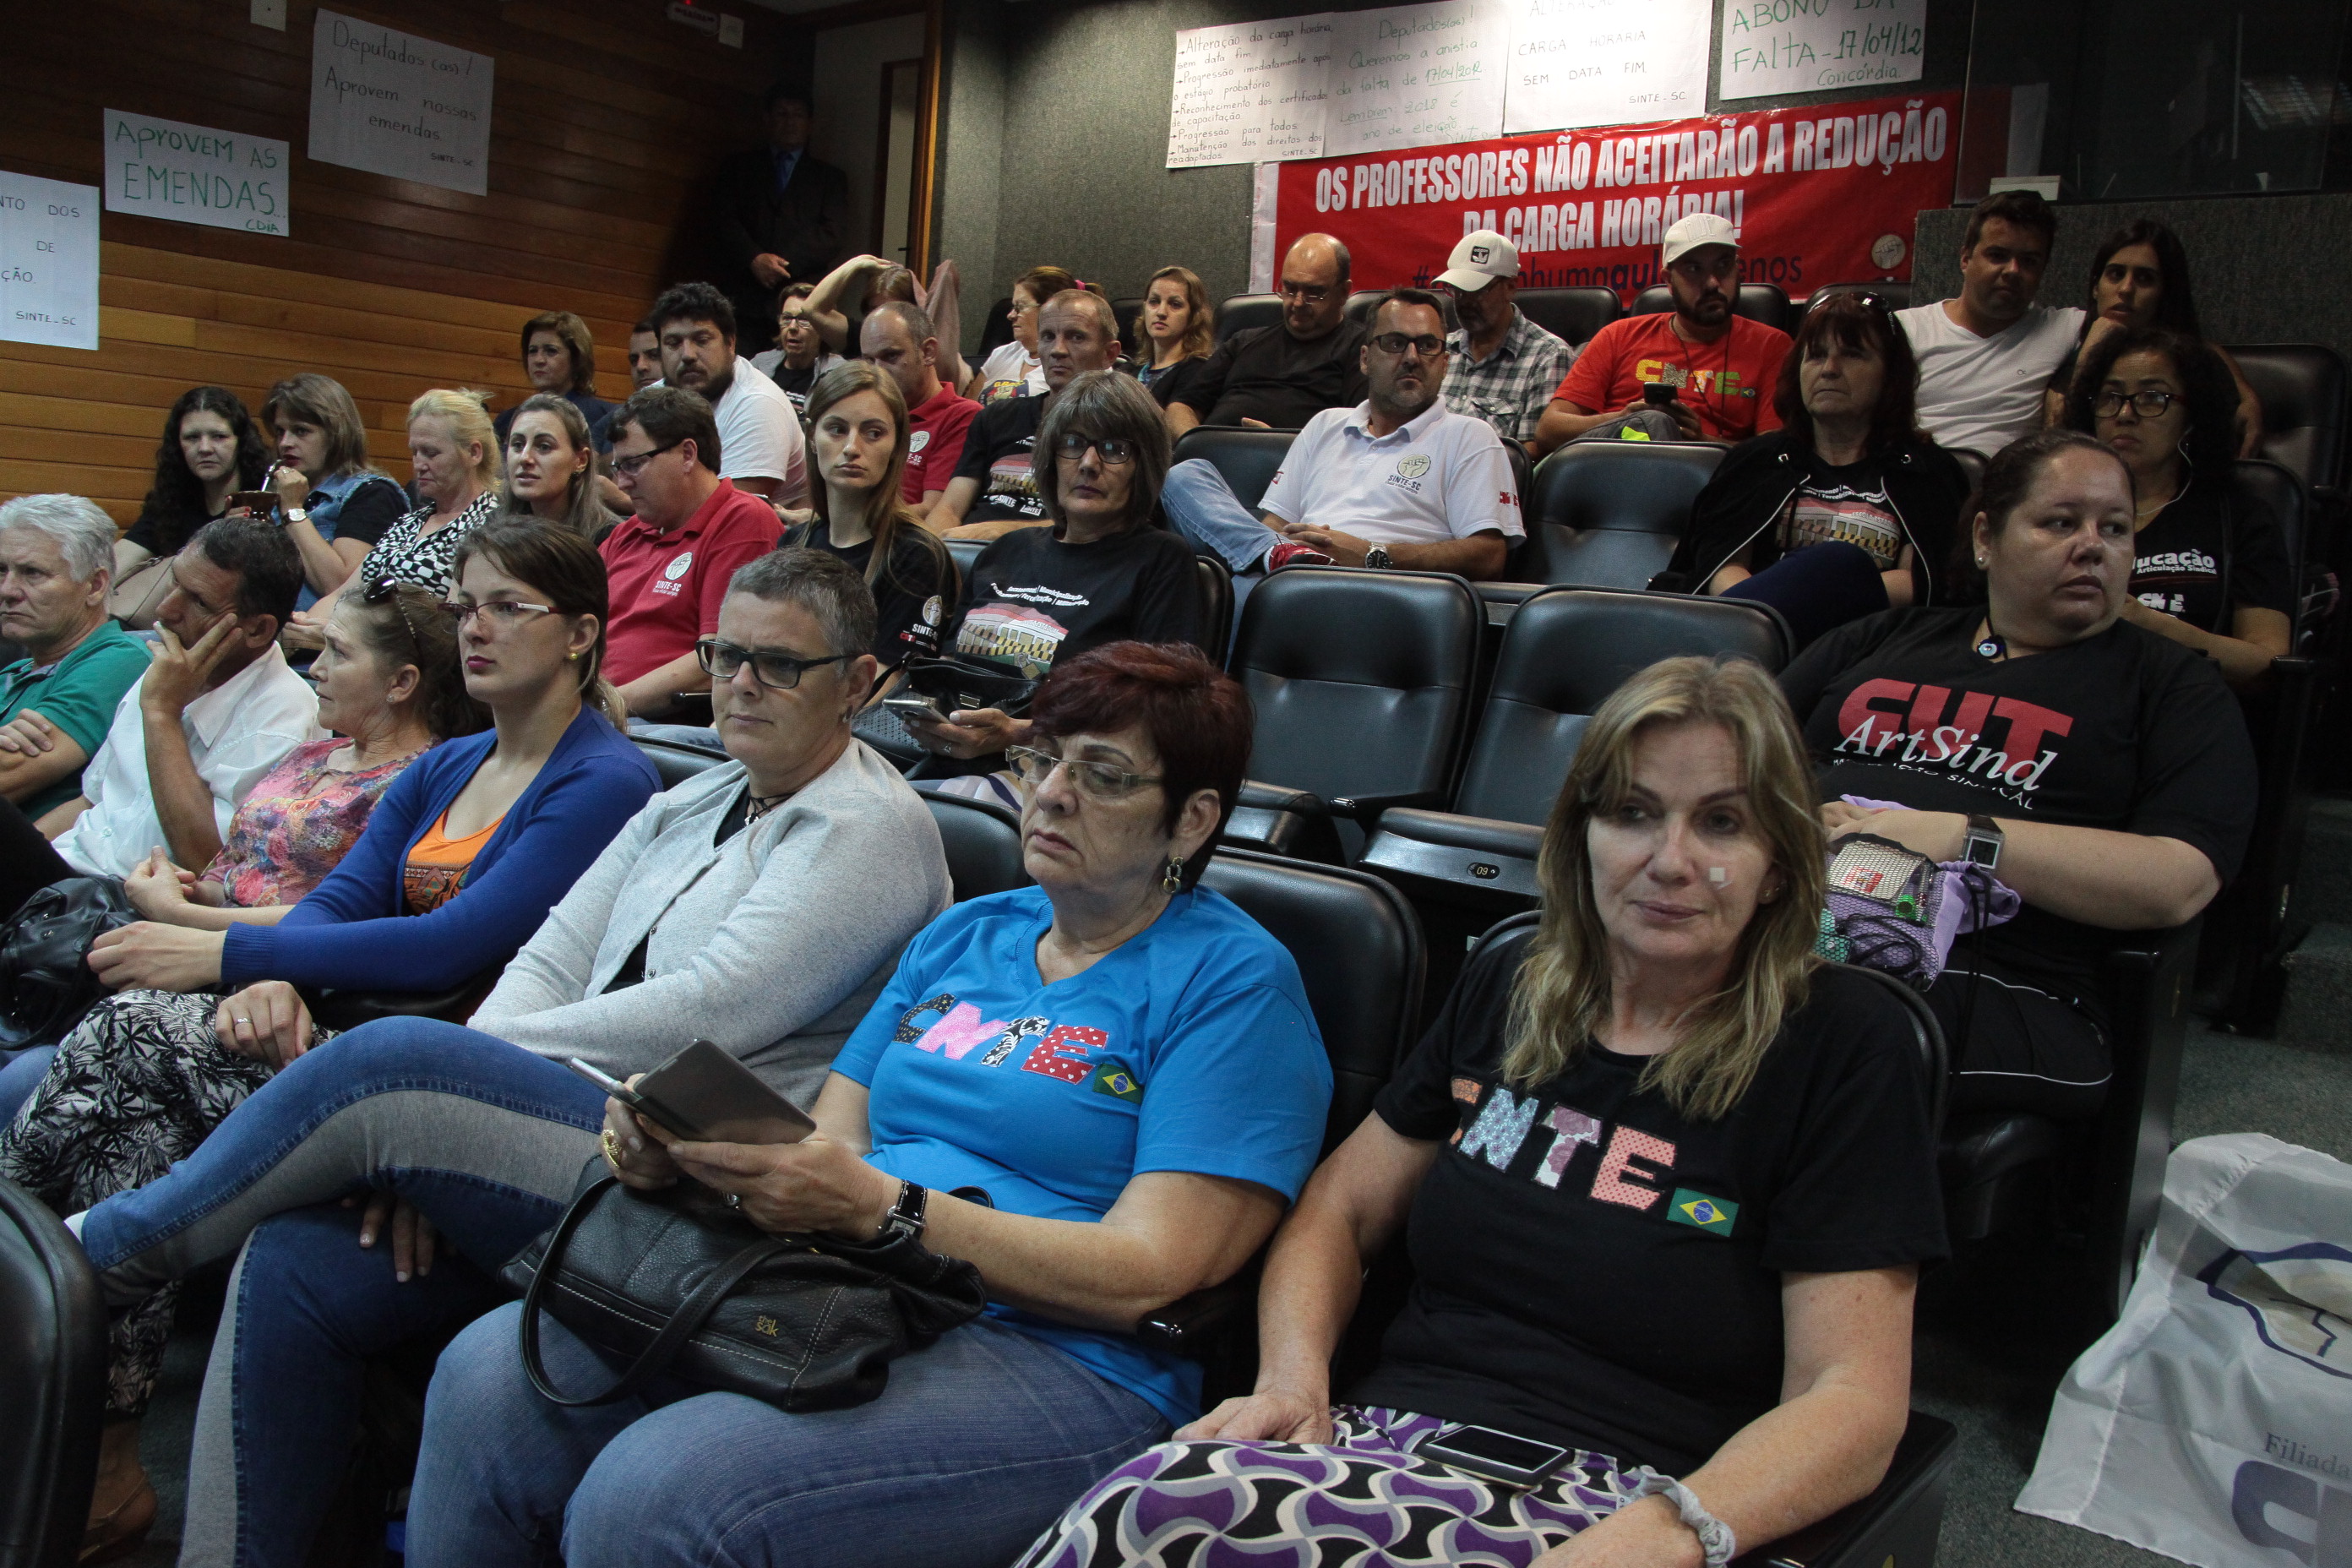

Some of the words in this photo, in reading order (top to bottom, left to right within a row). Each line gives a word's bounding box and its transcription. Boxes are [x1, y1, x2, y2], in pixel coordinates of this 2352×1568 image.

[1185, 35, 1240, 54] Alteração
[1250, 28, 1263, 43] da
[1518, 39, 1567, 56] CARGA
[1177, 61, 1196, 70] sem
[1204, 53, 1225, 64] data
[1348, 51, 1410, 69] Queremos
[1419, 50, 1429, 58] a
[1436, 37, 1478, 56] anistia
[1183, 68, 1234, 88] Progressão
[1244, 52, 1307, 74] imediatamente
[1523, 74, 1549, 86] SEM
[1568, 66, 1603, 80] DATA
[324, 65, 400, 104] Aprovem
[422, 97, 477, 122] nossas
[1184, 87, 1214, 101] estágio
[1223, 79, 1271, 100] probatório
[1336, 80, 1352, 95] da
[1360, 76, 1390, 92] falta
[1402, 73, 1417, 85] de
[1179, 95, 1250, 115] Reconhecimento
[1258, 95, 1272, 106] dos
[1280, 89, 1328, 104] certificados
[1404, 98, 1438, 114] 2018
[1450, 90, 1463, 107] é
[1171, 119, 1181, 128] de
[1187, 112, 1241, 131] capacitação
[1362, 129, 1380, 141] ano
[1388, 124, 1402, 135] de
[1177, 139, 1228, 154] Manutenção
[1242, 136, 1257, 147] dos
[1266, 133, 1301, 145] direitos
[1309, 132, 1323, 142] dos
[1178, 128, 1229, 144] Progressão
[1242, 126, 1261, 141] para
[249, 147, 277, 169] AS
[1315, 166, 1348, 213] OS
[1352, 147, 1529, 210] PROFESSORES
[1533, 134, 1592, 194] NÃO
[1594, 117, 1759, 189] ACEITARÃO
[1762, 123, 1785, 175] A
[1792, 99, 1947, 176] REDUÇÃO
[47, 204, 80, 218] DOS
[1505, 201, 1595, 254] CARGA
[36, 240, 55, 253] DE
[1636, 359, 1741, 395] CNTE
[1388, 475, 1421, 491] SINTE-SC
[2132, 548, 2216, 570] ucação
[2137, 564, 2186, 574] Articulação
[2187, 564, 2218, 574] Sindical
[655, 580, 682, 592] SINTE-SC
[1838, 678, 2074, 779] CUT
[1833, 715, 2059, 792] ArtSind
[1476, 866, 1489, 876] 09
[892, 993, 1109, 1086] CNTE
[2262, 1431, 2351, 1479] Filiada
